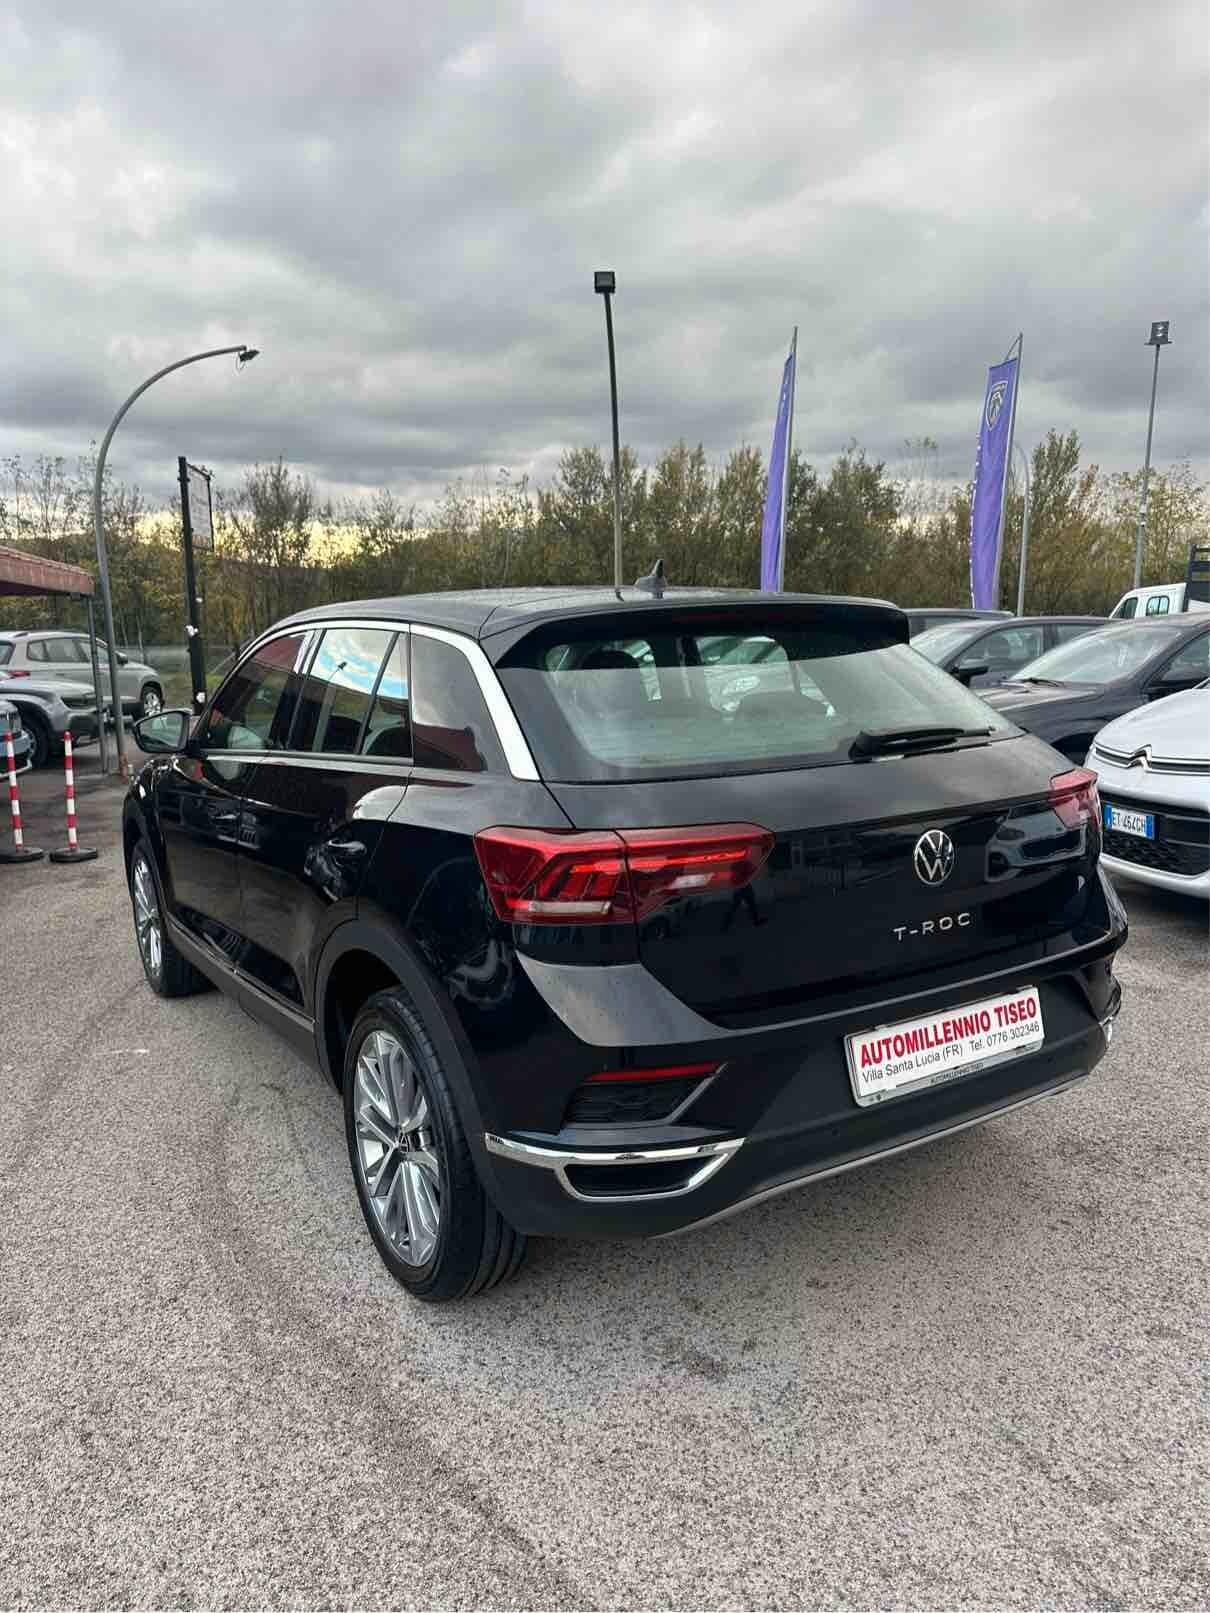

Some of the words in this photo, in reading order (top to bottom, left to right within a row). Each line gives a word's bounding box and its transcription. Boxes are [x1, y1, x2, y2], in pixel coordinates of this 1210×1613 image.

[893, 912, 970, 941] T-ROC
[861, 1010, 991, 1068] AUTOMILLENNIO
[994, 997, 1036, 1027] TISEO
[862, 1068, 884, 1083] Villa
[885, 1059, 914, 1076] Santa
[915, 1051, 941, 1068] Lucia
[942, 1044, 963, 1063] (FR)
[969, 1039, 985, 1051] Tel.
[986, 1031, 1008, 1047] 0776
[1010, 1021, 1040, 1040] 302346
